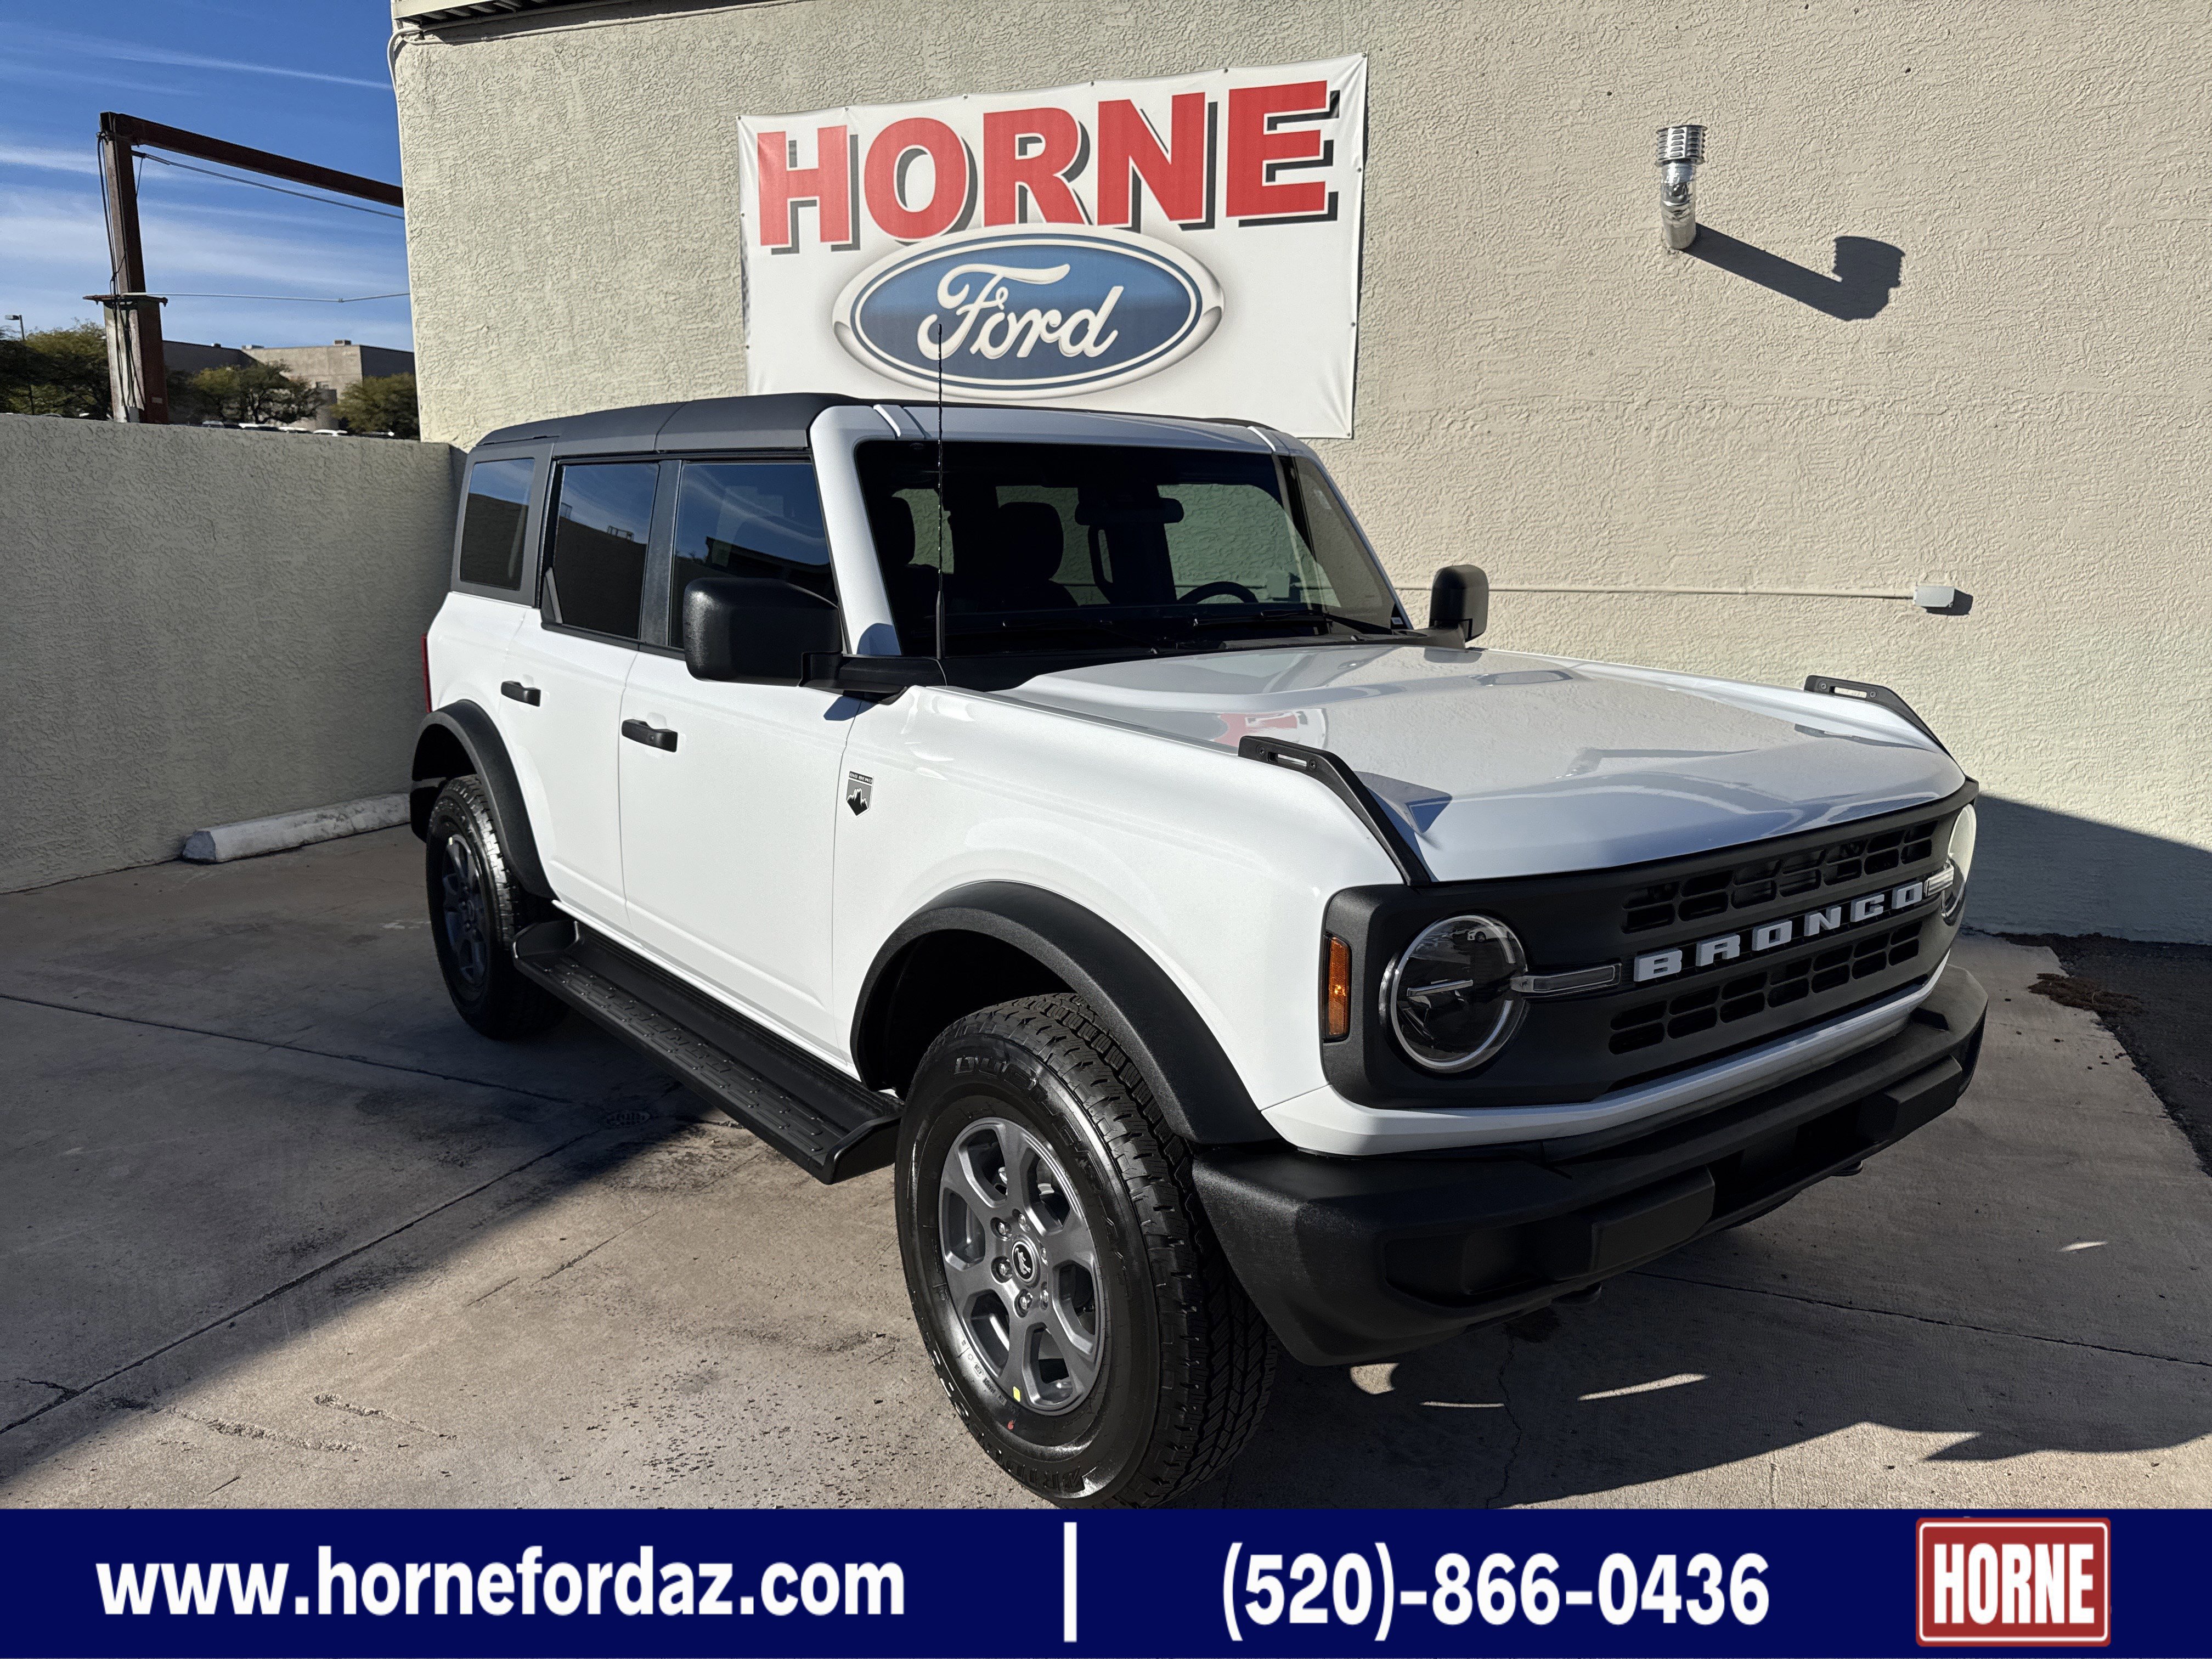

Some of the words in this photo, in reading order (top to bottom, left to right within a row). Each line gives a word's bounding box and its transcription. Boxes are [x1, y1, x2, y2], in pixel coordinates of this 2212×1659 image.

[757, 80, 1340, 255] HORNE
[916, 263, 1125, 360] Ford
[1633, 881, 1923, 983] BRONCO
